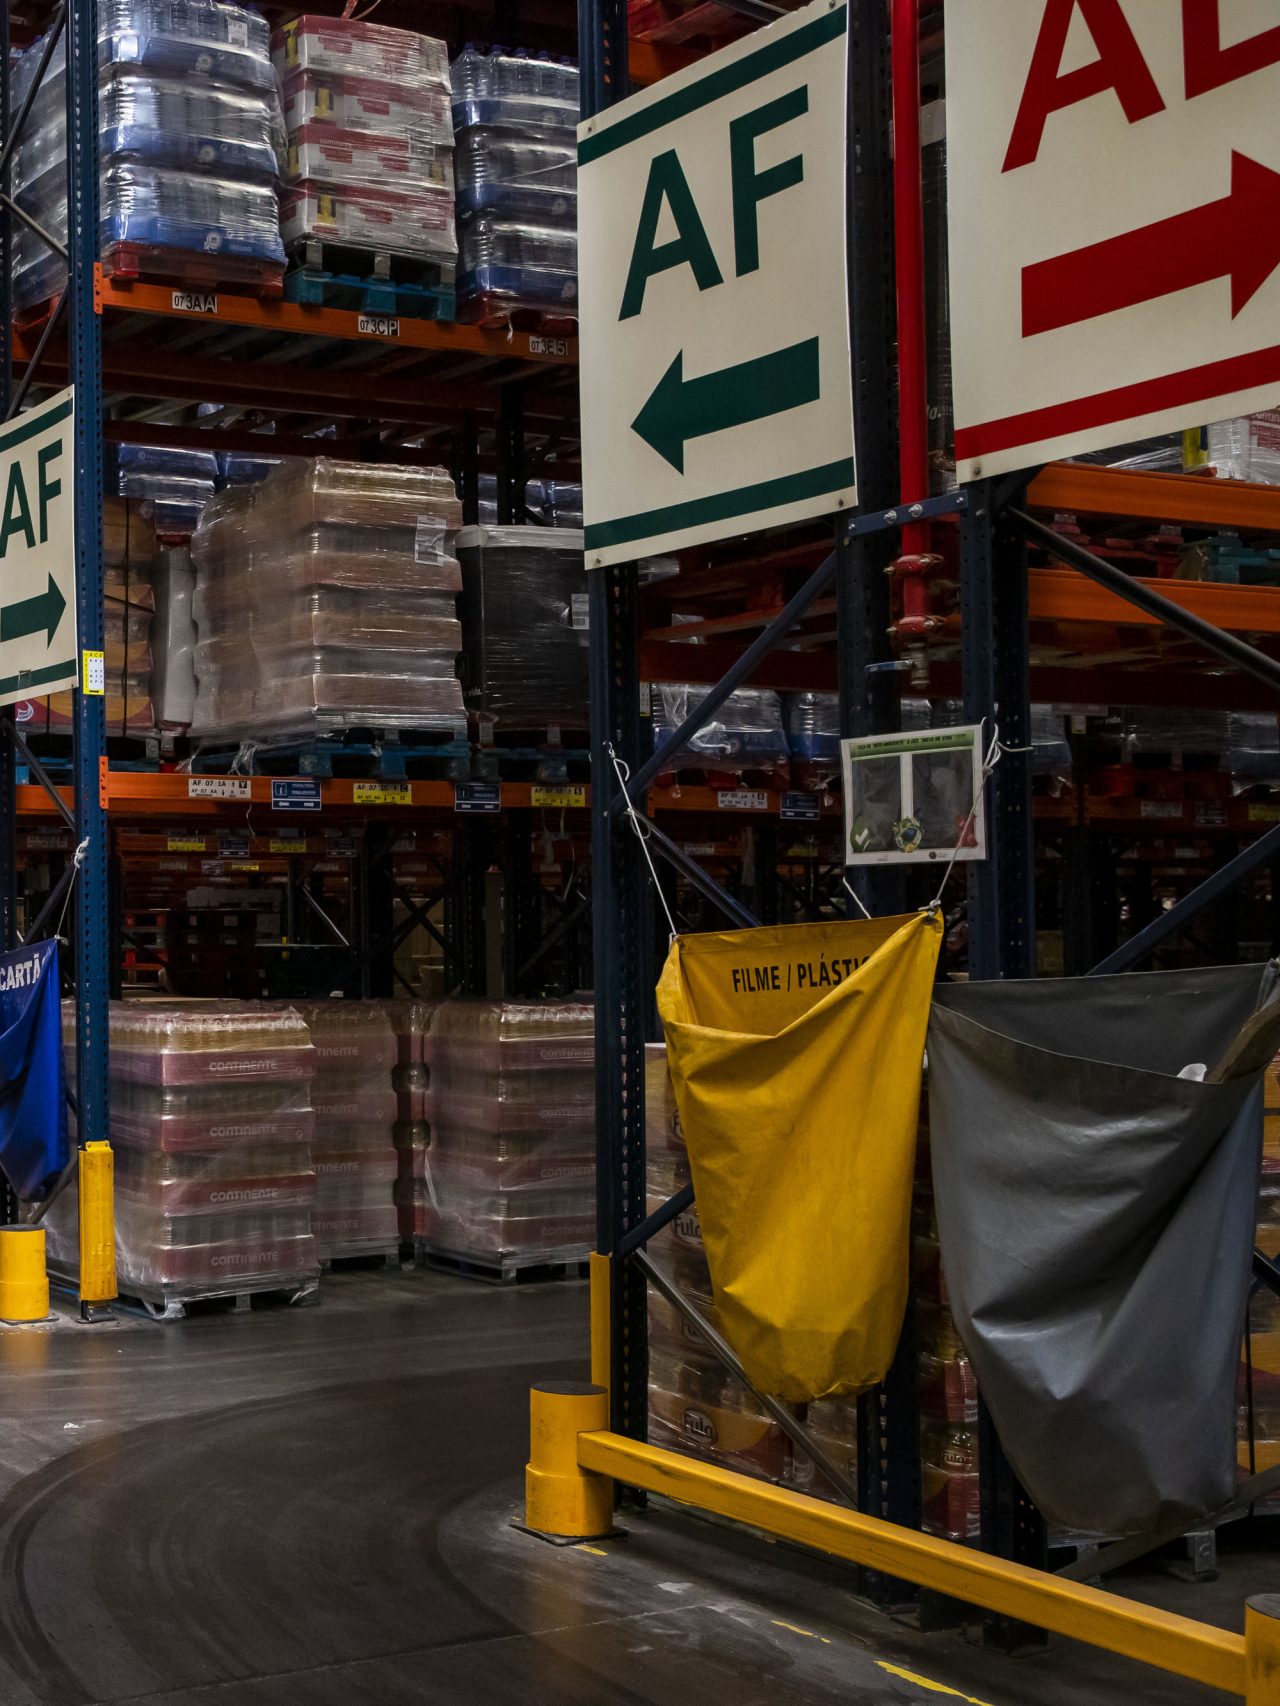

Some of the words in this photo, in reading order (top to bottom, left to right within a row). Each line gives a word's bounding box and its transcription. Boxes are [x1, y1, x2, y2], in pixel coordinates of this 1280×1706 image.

[1001, 0, 1280, 174] A
[618, 83, 809, 321] AF
[732, 965, 781, 993] FILME
[787, 964, 792, 992] /
